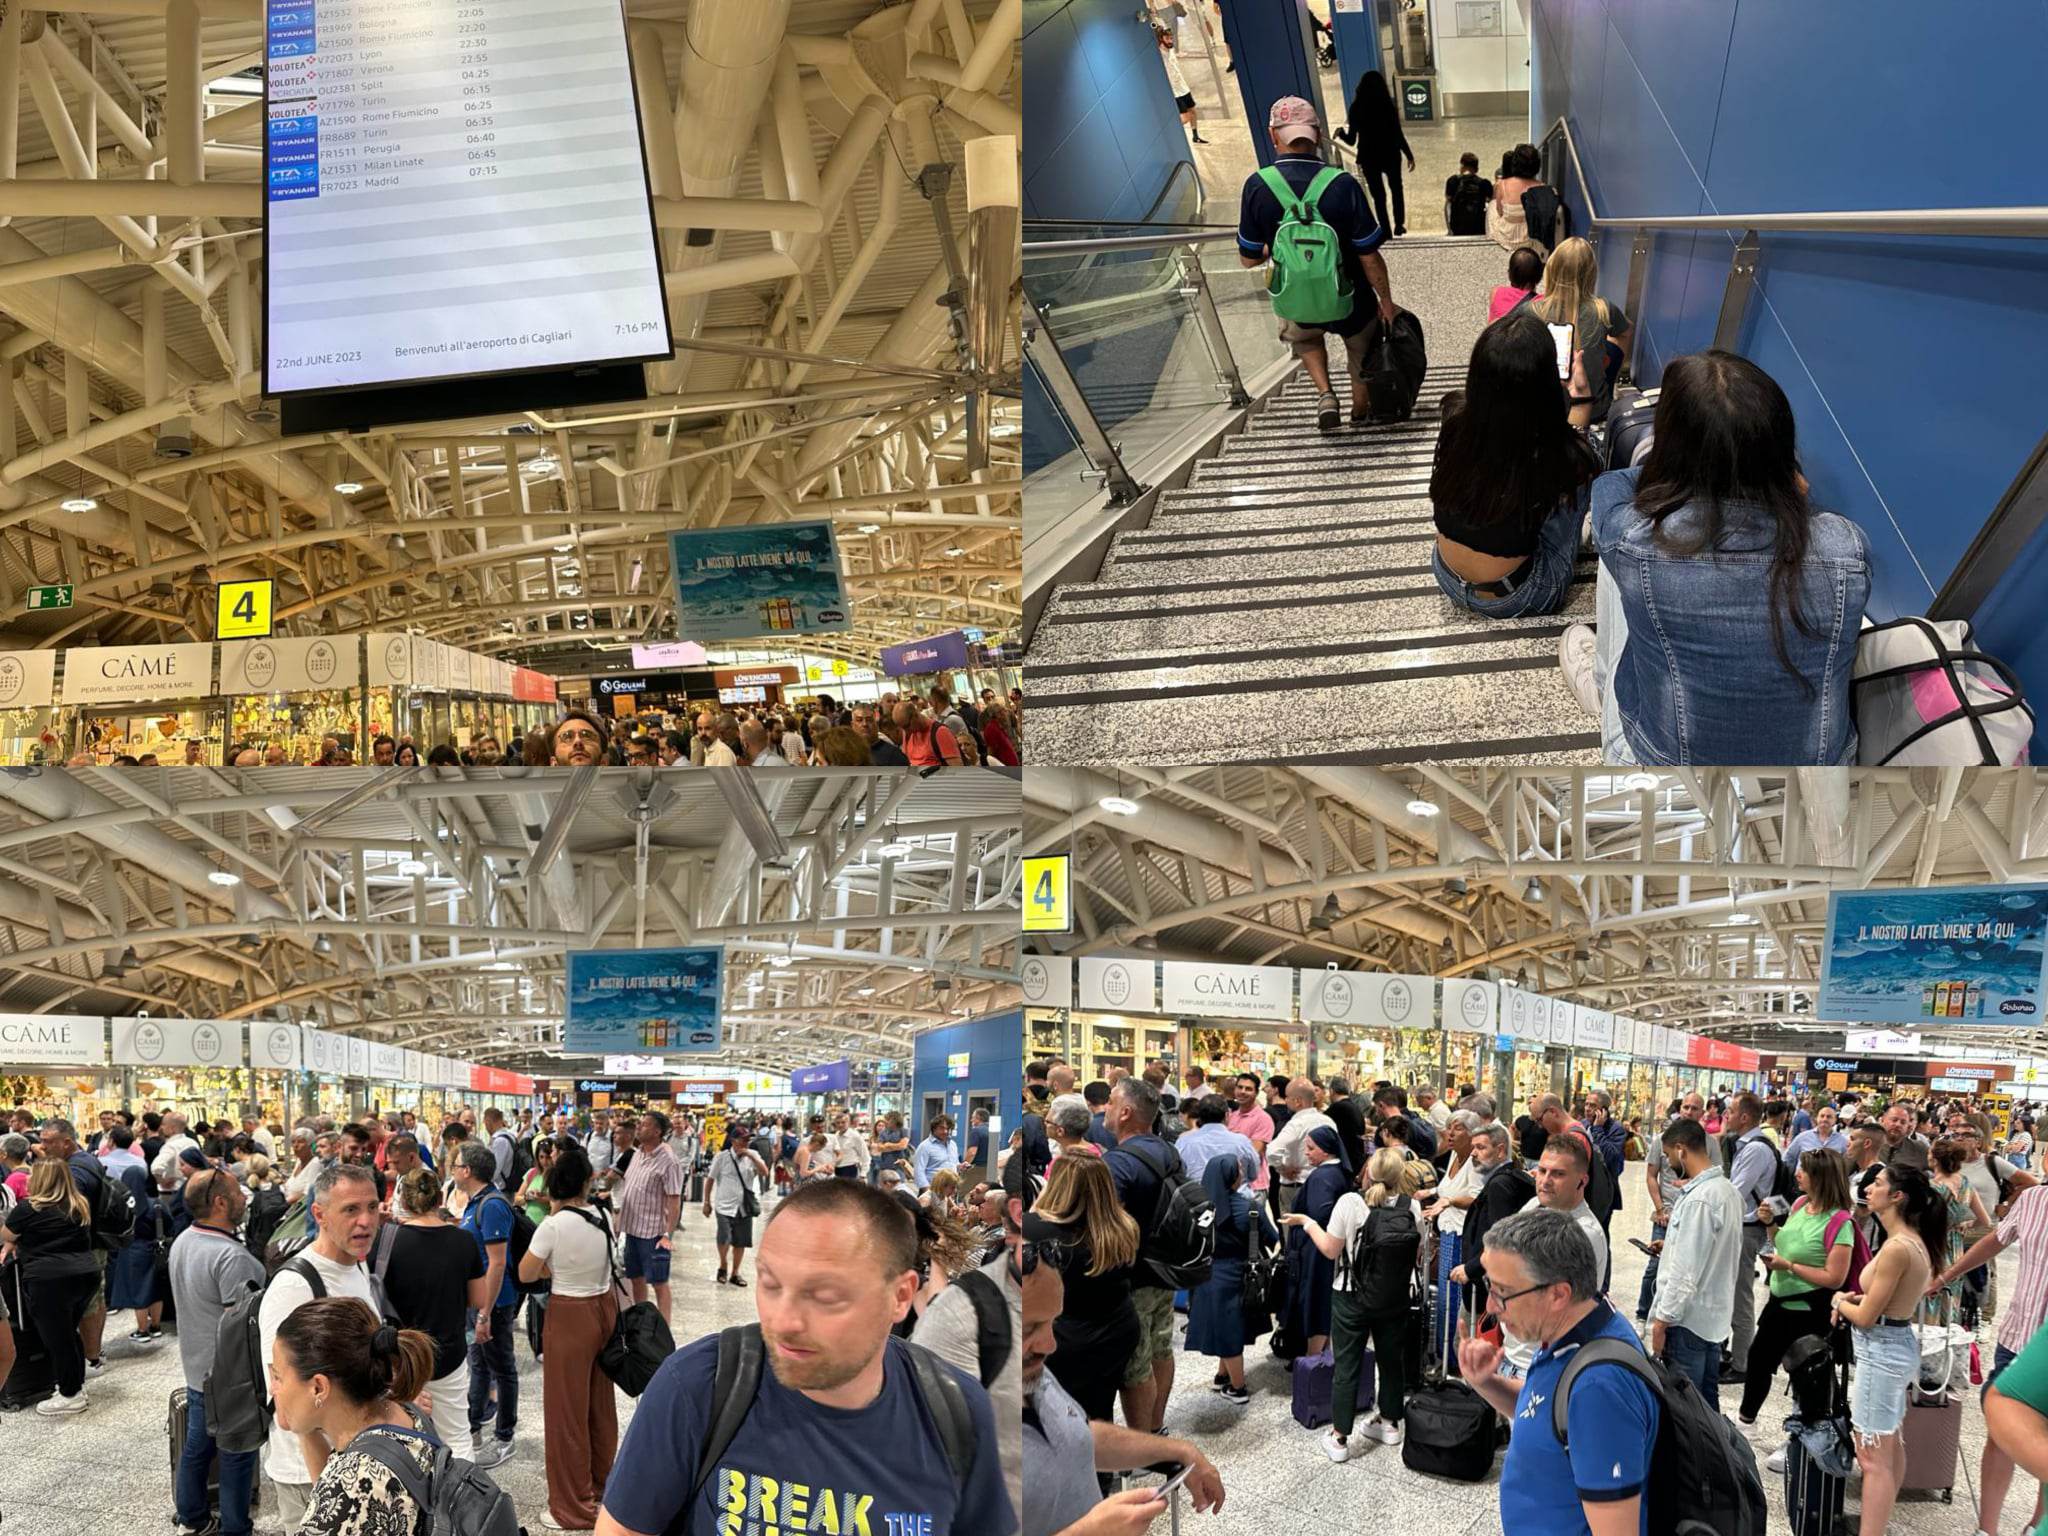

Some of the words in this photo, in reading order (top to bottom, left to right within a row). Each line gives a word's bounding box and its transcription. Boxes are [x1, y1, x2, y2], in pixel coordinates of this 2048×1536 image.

[457, 8, 484, 18] 22:05
[277, 29, 312, 38] RYANAIR
[459, 23, 486, 33] 22:20
[360, 35, 386, 44] Rome
[460, 38, 487, 49] 22:30
[269, 62, 306, 72] VOLOTEA
[360, 50, 382, 61] Lyon
[269, 77, 306, 88] VOLOTEA
[360, 64, 394, 75] Verona
[277, 87, 313, 98] CROATIA
[361, 80, 384, 91] Split
[463, 84, 491, 96] 06:15
[269, 108, 307, 119] VOLOTEA
[362, 96, 386, 106] Turin
[464, 100, 492, 111] 06:25
[320, 115, 356, 126] AZ1590
[363, 111, 390, 122] Rome
[393, 106, 439, 119] Fiumicino
[465, 116, 494, 127] 06:35
[278, 138, 315, 146] RYANAIR
[320, 131, 356, 142] FR8689
[363, 127, 388, 138] Turin
[466, 132, 495, 143] 06:40
[278, 154, 315, 163] RYANAIR
[320, 148, 356, 159] FR1511
[364, 144, 401, 156] Perugia
[468, 148, 496, 160] 06:45
[321, 164, 357, 175] AZ1531
[364, 160, 391, 171] Milan
[394, 156, 424, 168] Linate
[469, 165, 497, 176] 07:15
[278, 186, 316, 196] RYANAIR
[321, 181, 358, 192] FR7023
[365, 175, 399, 187] Madrid
[615, 323, 638, 335] 7:16
[641, 321, 658, 332] PM
[395, 343, 448, 357] Benvenuti
[450, 336, 518, 352] all'aeroporto
[519, 333, 530, 344] di
[531, 329, 572, 344] Cagliari
[276, 358, 302, 369] 22nd
[305, 354, 333, 366] JUNE
[335, 351, 362, 363] 2023
[706, 555, 735, 569] NOSTRO
[736, 554, 757, 567] LATTE
[759, 552, 781, 566] VIENE
[784, 552, 795, 564] DA
[232, 591, 257, 623] 4
[102, 653, 177, 678] CÀMÉ
[835, 663, 845, 673] 5
[147, 682, 166, 690] HOME
[1034, 870, 1055, 912] 4
[1872, 925, 1907, 940] NOSTRO
[1911, 925, 1939, 940] LATTE
[1943, 923, 1973, 939] VIENE
[1977, 924, 1991, 938] DA
[1994, 923, 2016, 938] QUI.
[626, 976, 645, 989] LATTE
[1194, 972, 1260, 996] CÀMÉ
[1, 1022, 72, 1044] CÀMÉ
[707, 1123, 714, 1135] 6
[717, 1467, 874, 1536] BREAK
[884, 1512, 933, 1536] THE
